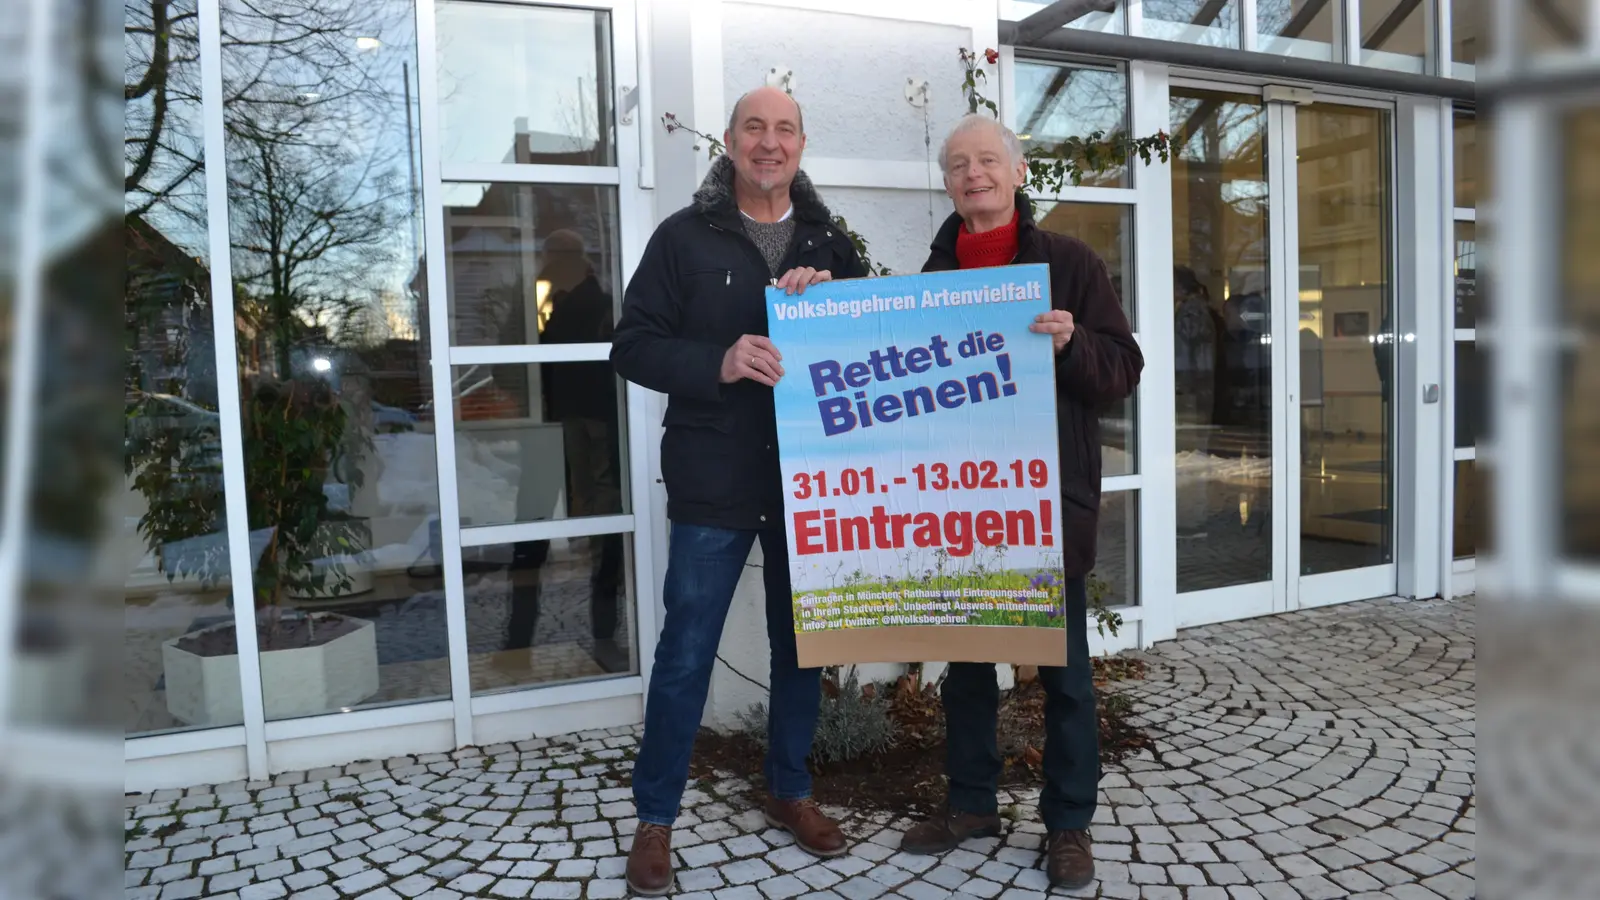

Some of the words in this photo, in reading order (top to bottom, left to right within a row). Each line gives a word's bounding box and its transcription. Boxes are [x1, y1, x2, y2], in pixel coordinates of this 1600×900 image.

[774, 294, 916, 320] Volksbegehren
[921, 281, 1042, 309] Artenvielfalt
[809, 335, 952, 397] Rettet
[957, 330, 1005, 359] die
[818, 353, 1017, 436] Bienen!
[793, 500, 1053, 557] Eintragen!
[800, 593, 843, 605] Eintragen
[845, 592, 854, 601] in
[904, 588, 941, 599] Rathaus
[943, 588, 960, 598] und
[963, 588, 1049, 599] Eintragungsstellen
[802, 609, 811, 618] in
[813, 606, 840, 617] Ihrem
[843, 603, 901, 614] Stadtviertel.
[903, 601, 951, 612] Unbedingt
[954, 601, 993, 610] Ausweis
[996, 602, 1054, 612] mitnehmen!
[803, 621, 825, 631] Infos
[828, 618, 843, 628] auf
[845, 616, 879, 626] twitter:
[882, 614, 967, 625] @MVolksbegehren
